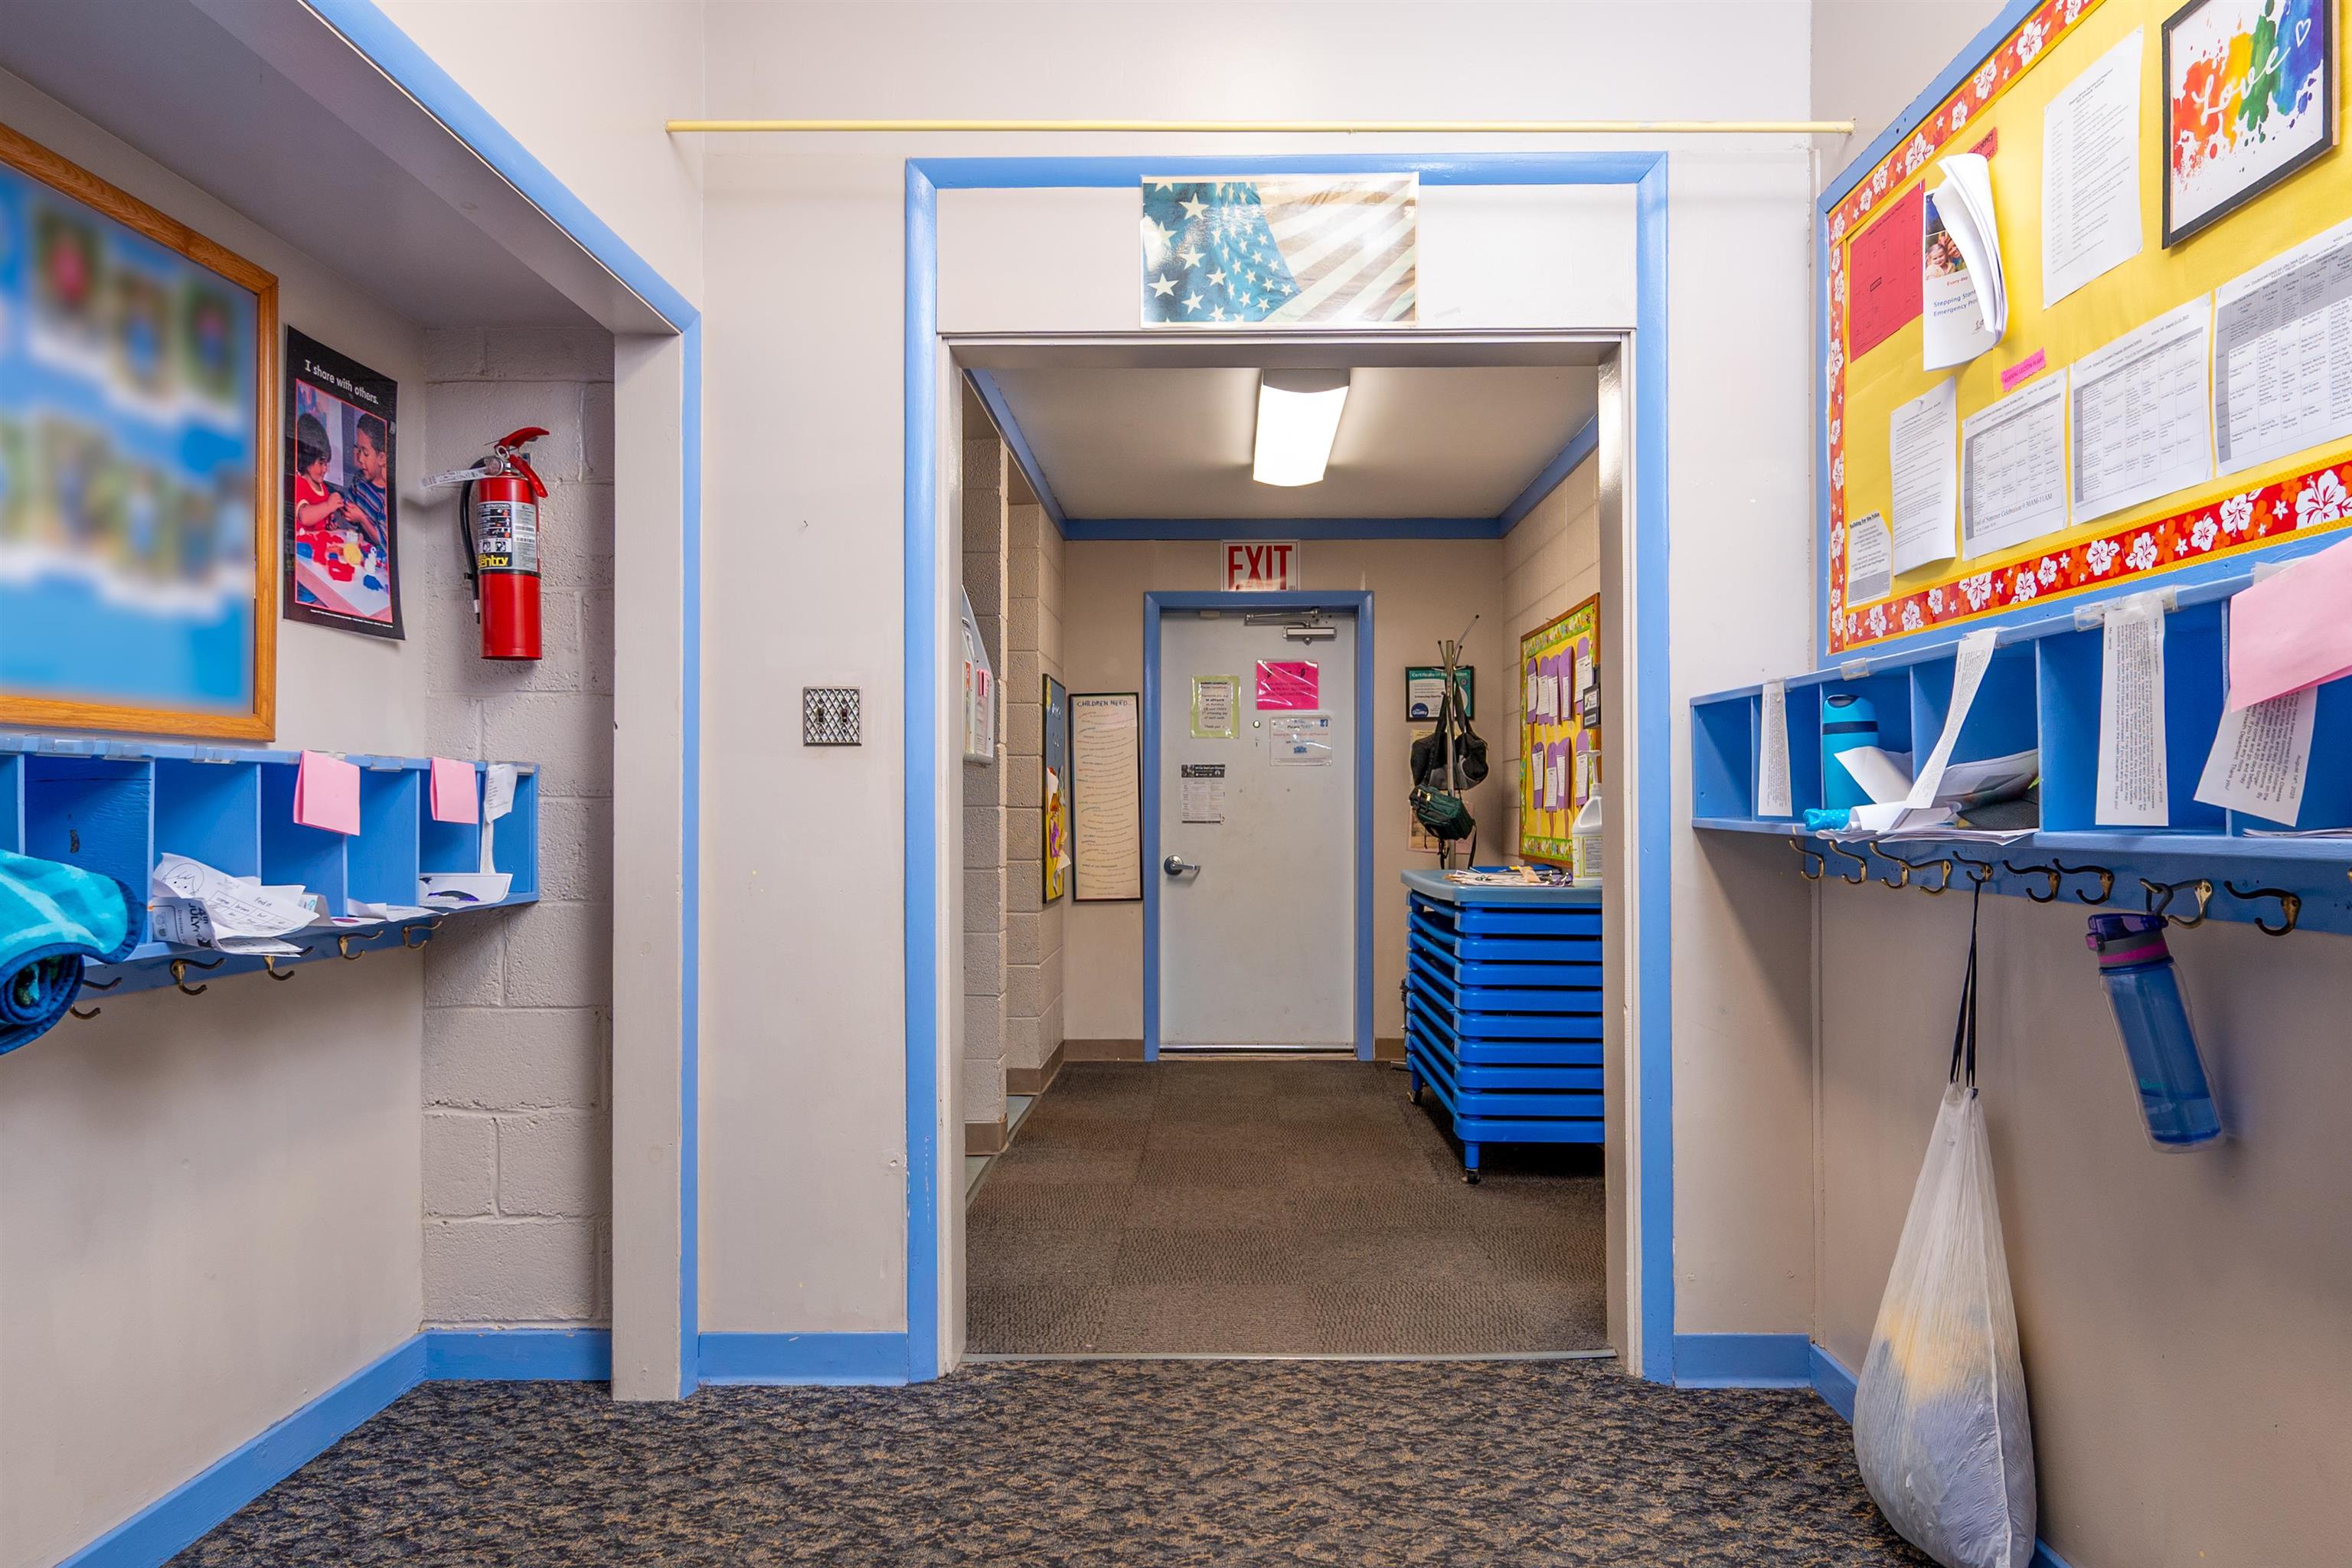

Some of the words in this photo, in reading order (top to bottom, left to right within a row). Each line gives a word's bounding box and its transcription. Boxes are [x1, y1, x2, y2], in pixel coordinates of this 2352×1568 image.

[1934, 296, 1960, 307] Stepping
[1934, 303, 1967, 316] Emergency
[305, 360, 311, 372] I
[313, 365, 335, 383] share
[337, 378, 352, 392] with
[355, 385, 379, 404] others.
[1228, 545, 1292, 590] EXIT
[188, 903, 200, 929] JULY
